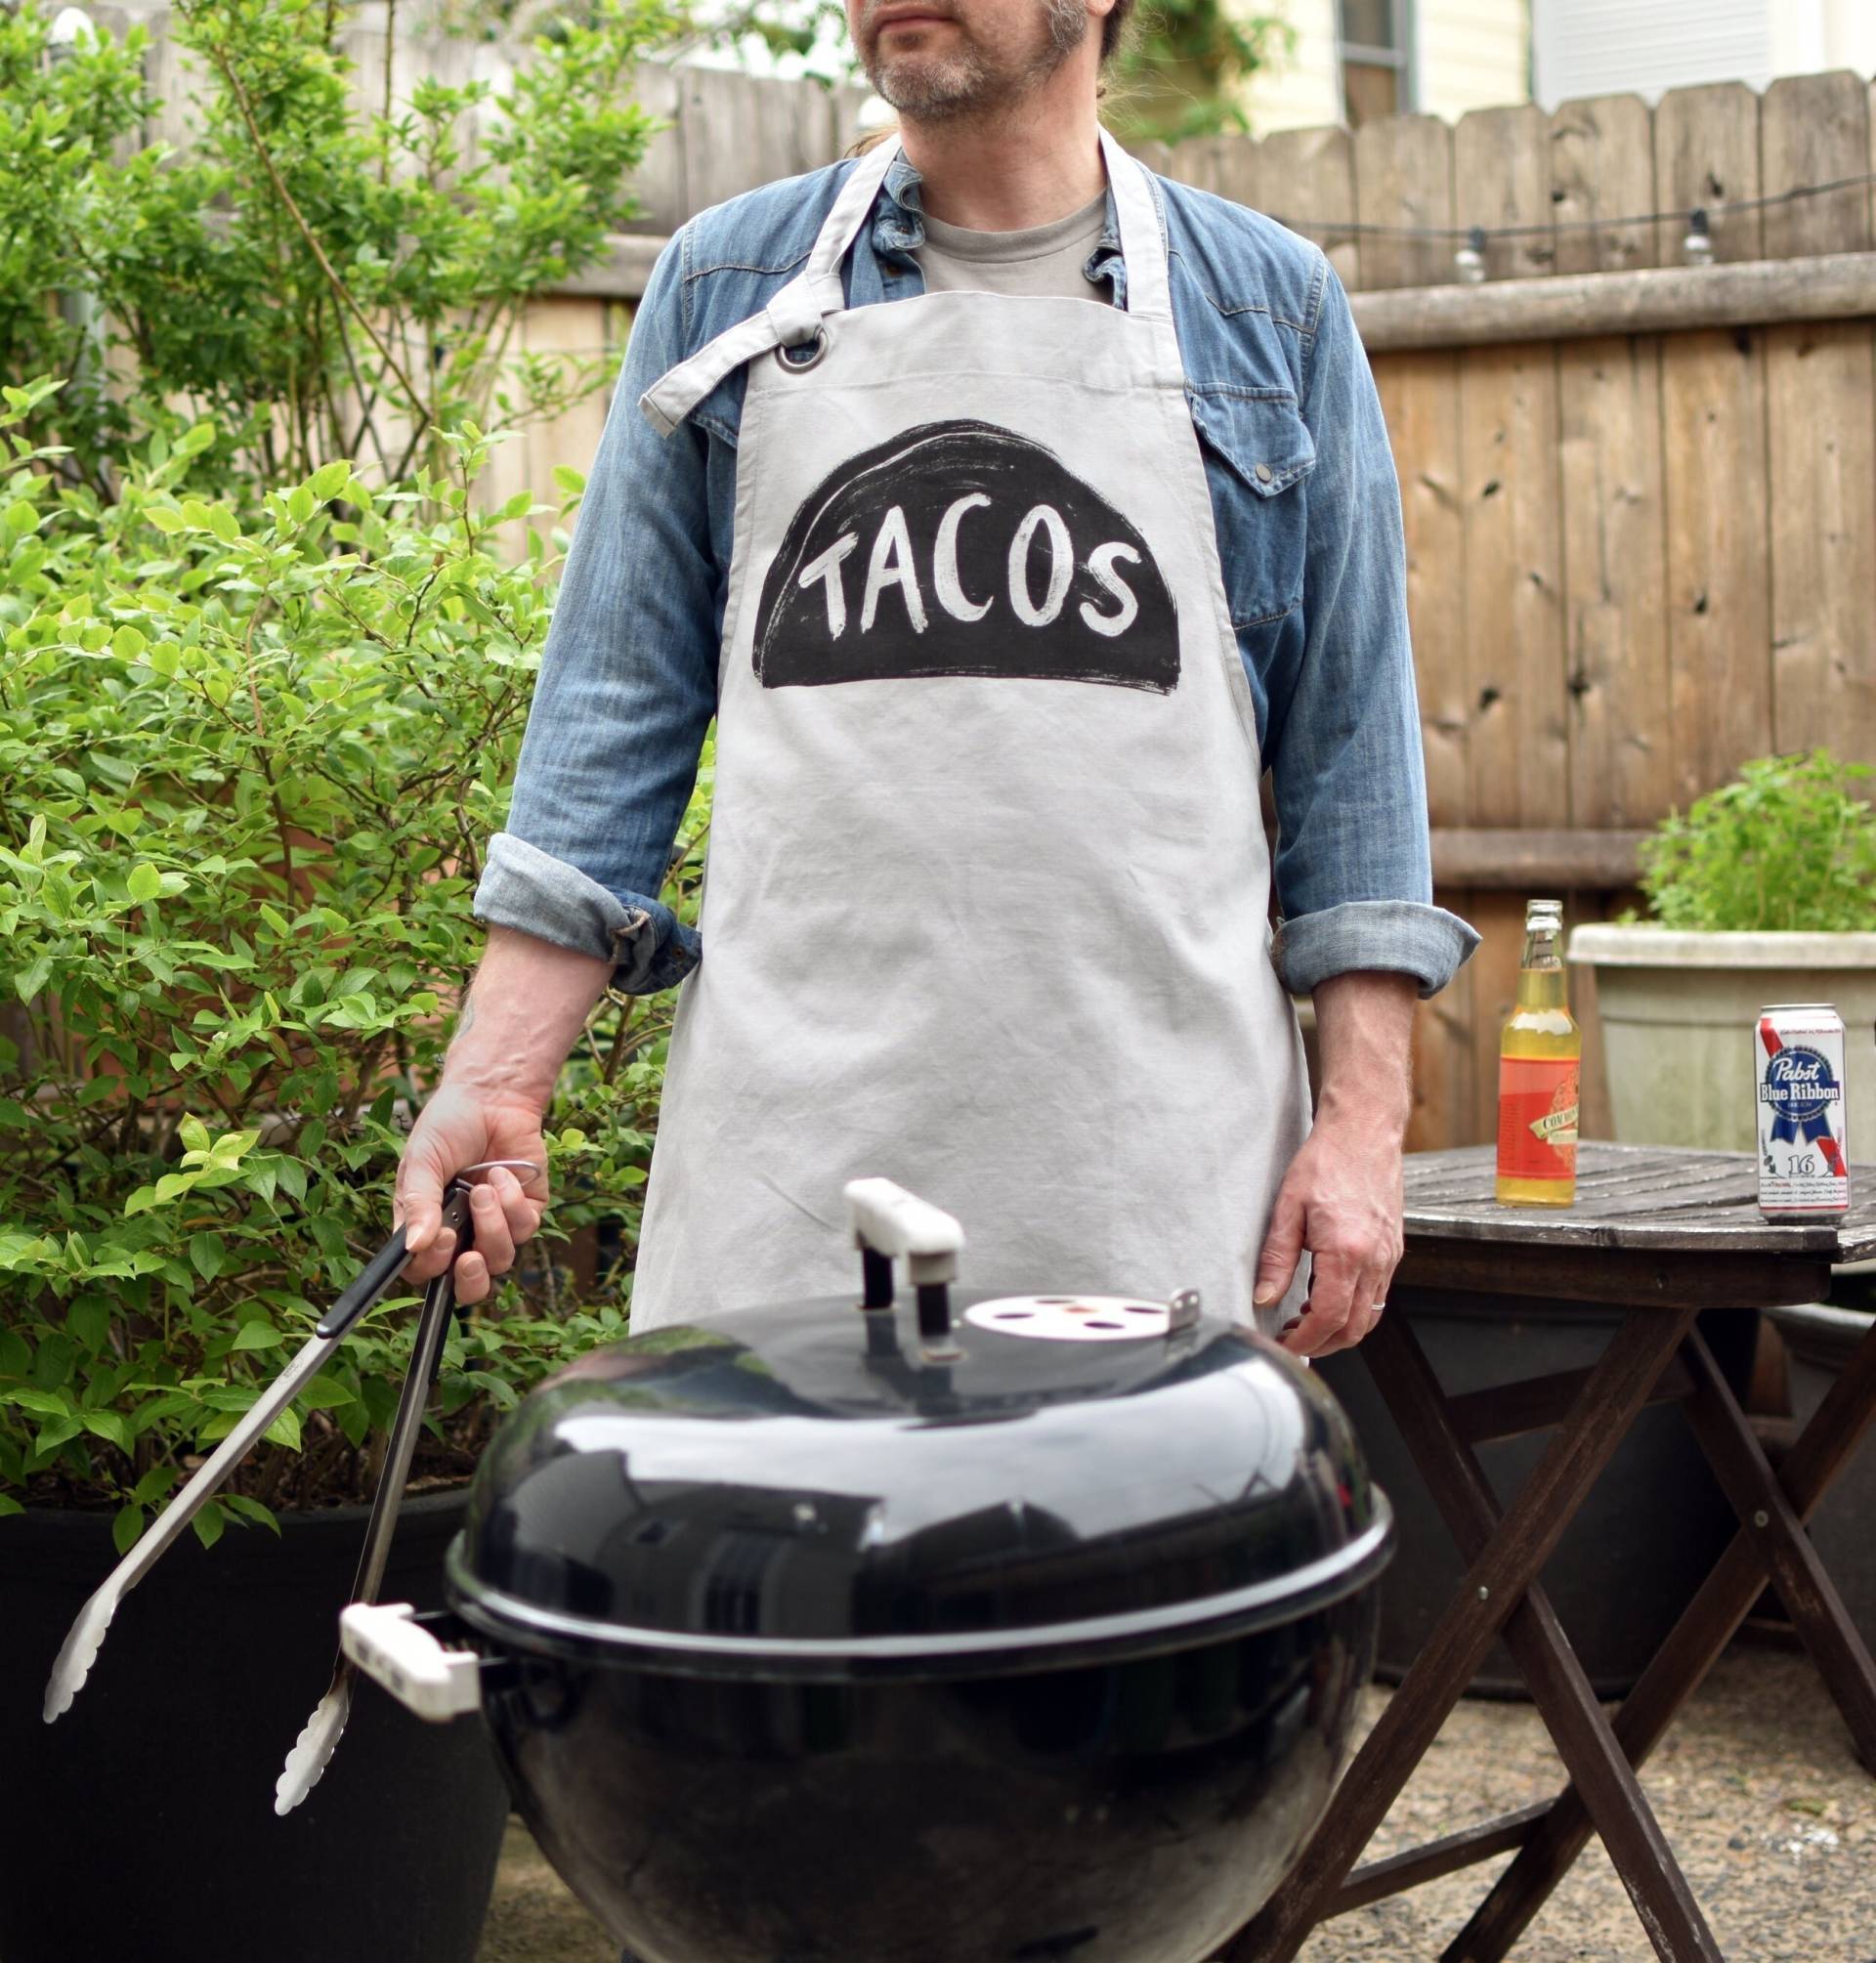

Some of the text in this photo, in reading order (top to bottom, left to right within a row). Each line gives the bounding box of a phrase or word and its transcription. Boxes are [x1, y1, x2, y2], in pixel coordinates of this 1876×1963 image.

[798, 492, 1142, 641] TACOS
[1772, 1057, 1820, 1081] Pabst
[1761, 1083, 1839, 1101] Blue Ribbon
[1788, 1154, 1814, 1174] 16
